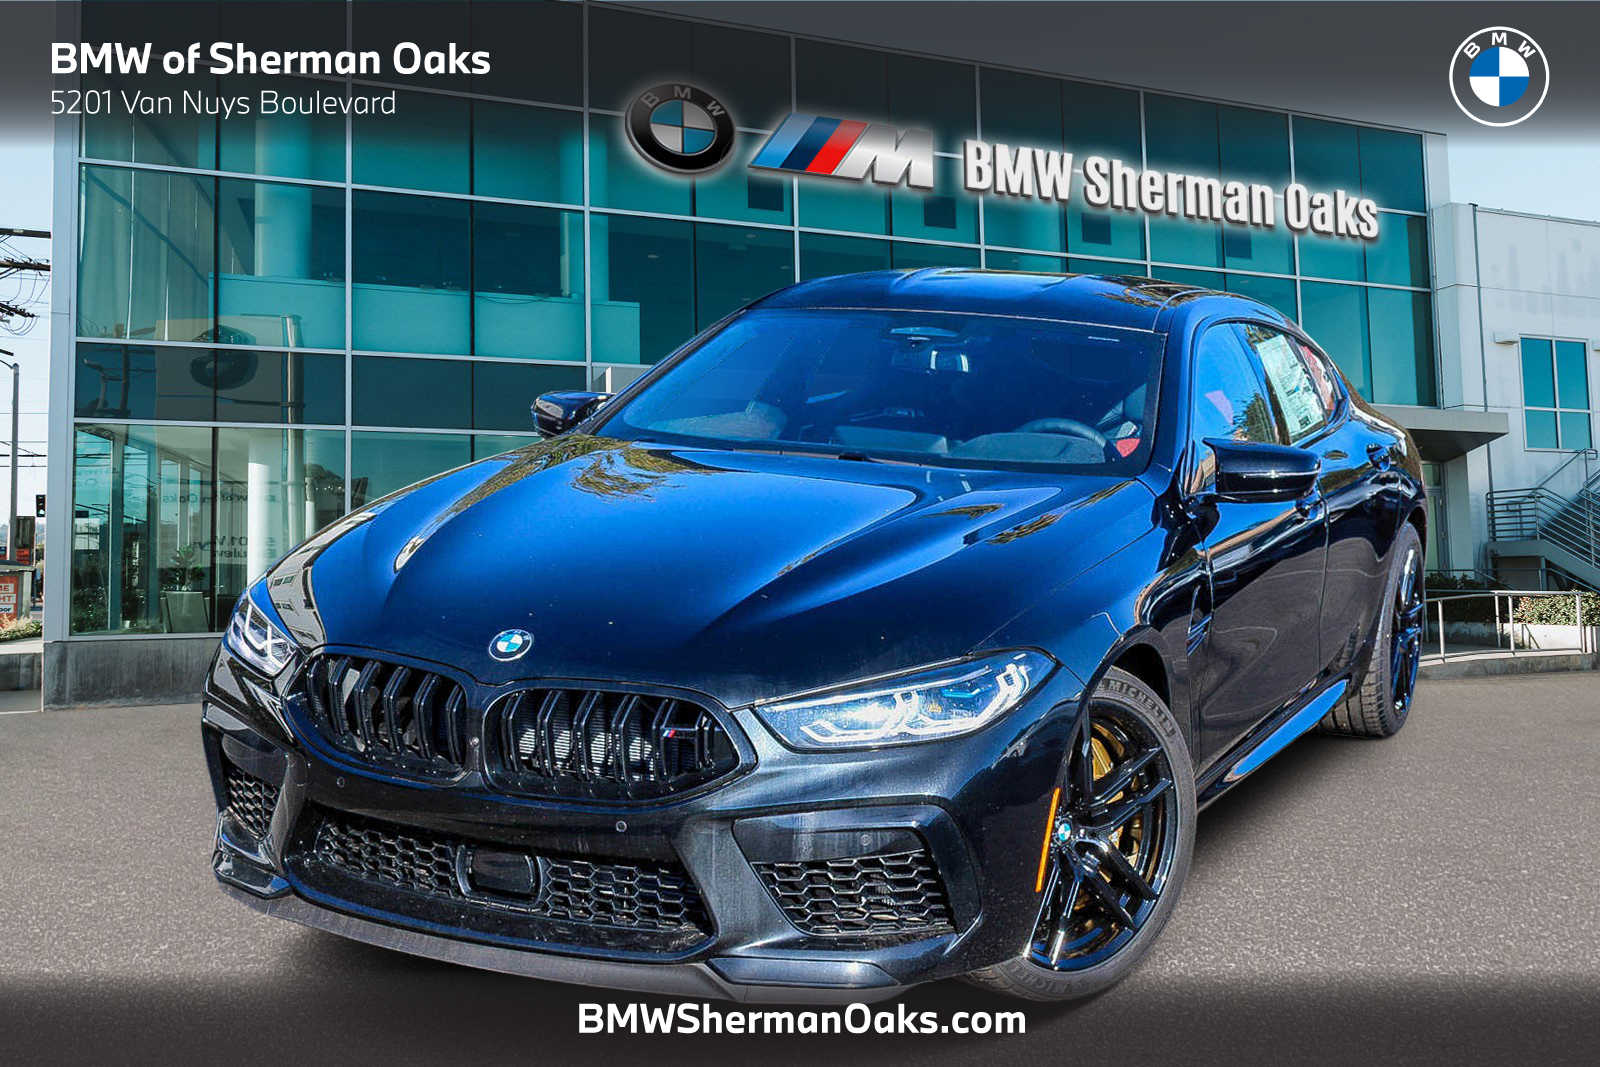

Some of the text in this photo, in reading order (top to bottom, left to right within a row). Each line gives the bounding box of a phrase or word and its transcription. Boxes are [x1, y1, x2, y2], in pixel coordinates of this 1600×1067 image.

[963, 139, 1379, 240] BMW Sherman Oaks
